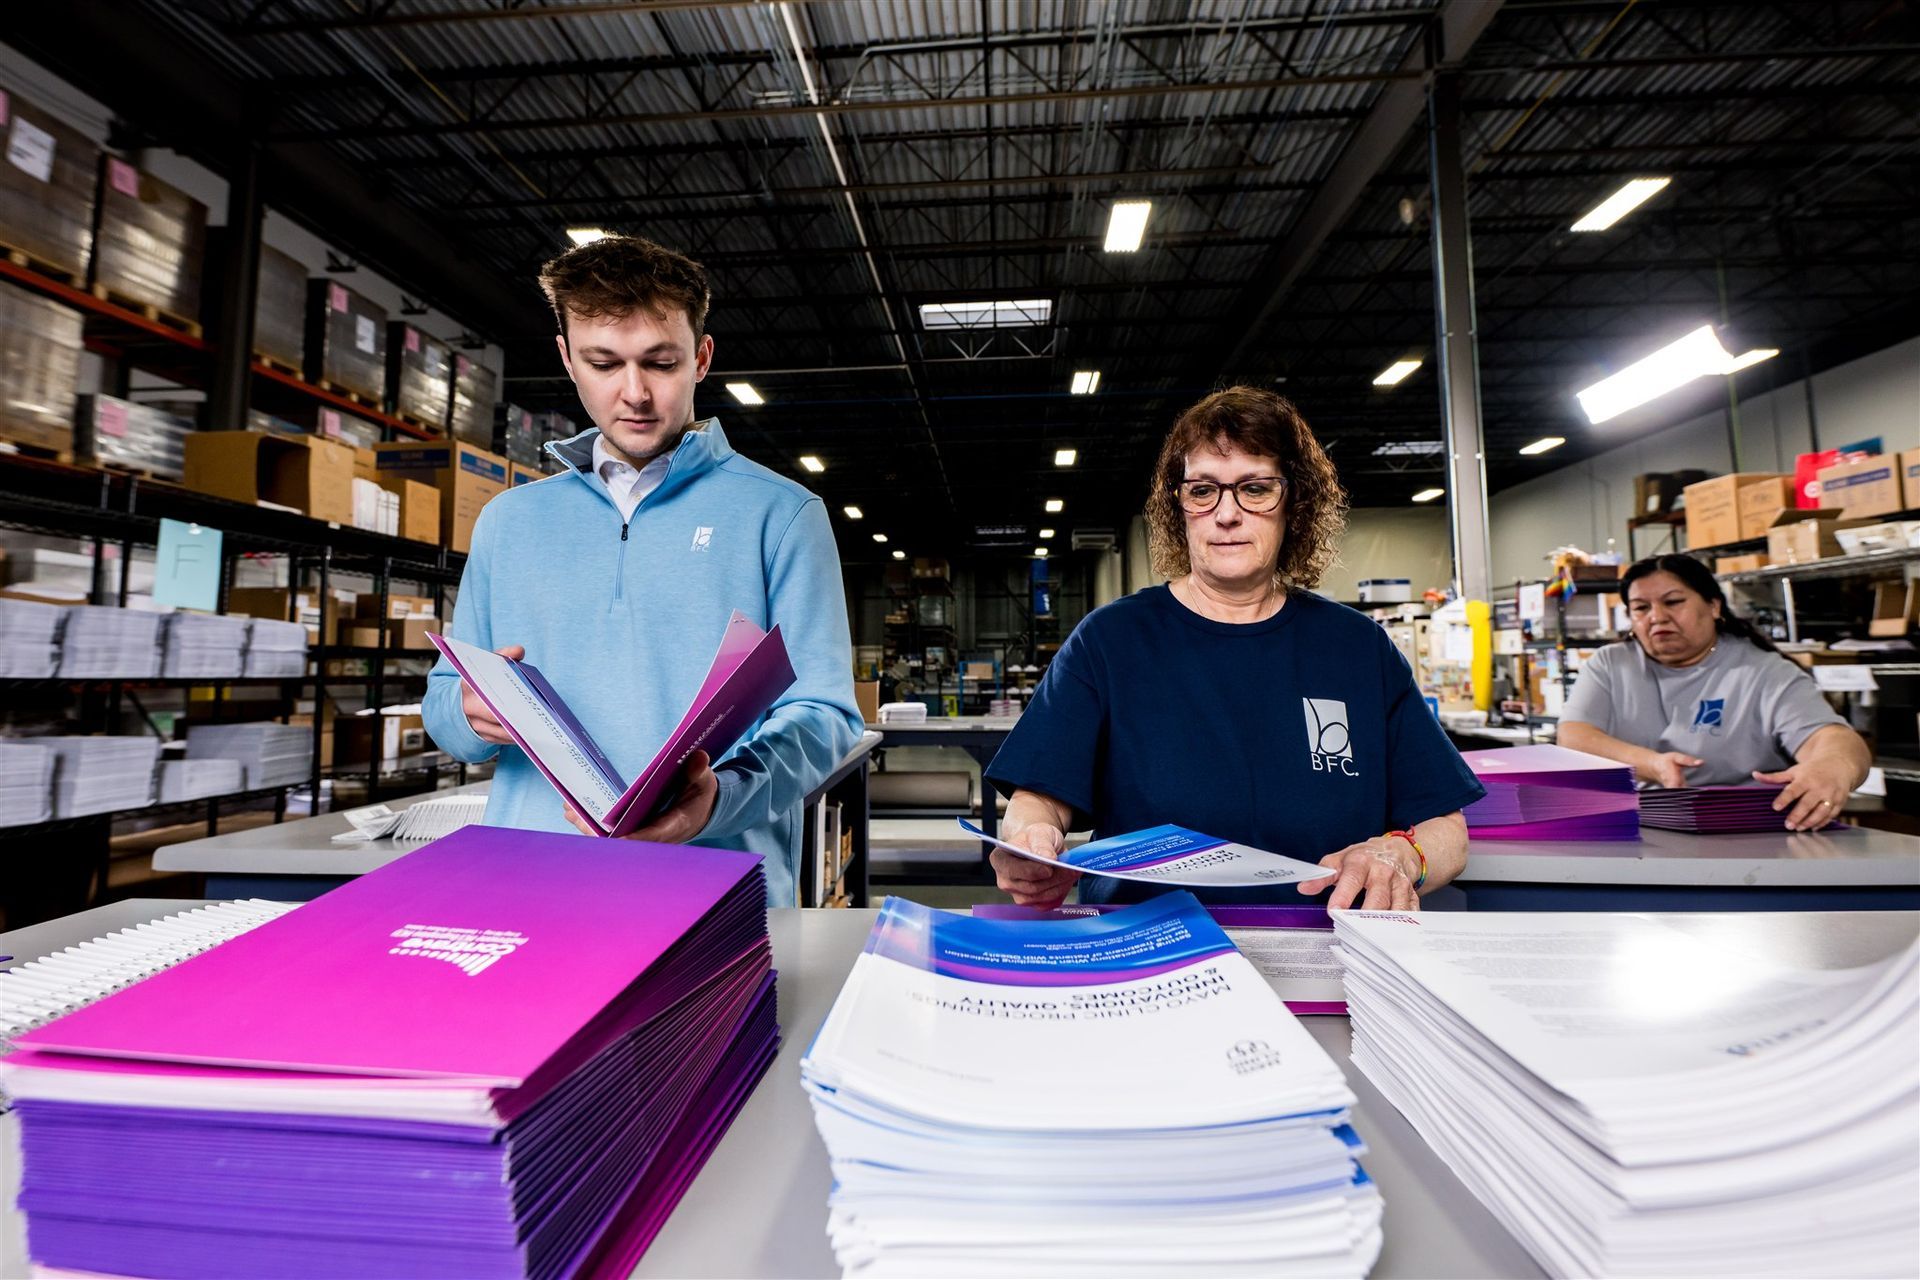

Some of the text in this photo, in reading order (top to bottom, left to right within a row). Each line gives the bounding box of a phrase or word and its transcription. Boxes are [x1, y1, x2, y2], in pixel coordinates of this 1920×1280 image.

[171, 543, 206, 580] F
[1090, 945, 1155, 962] Expectations
[1104, 940, 1155, 955] Treatment
[944, 949, 1000, 963] Medication
[1048, 952, 1090, 960] Patients
[1059, 957, 1089, 965] When
[1072, 973, 1199, 1002] OUTCOMES
[1165, 983, 1232, 1008] MAYO
[960, 995, 1058, 1010] QUALITY
[1083, 1003, 1161, 1020] CLINIC
